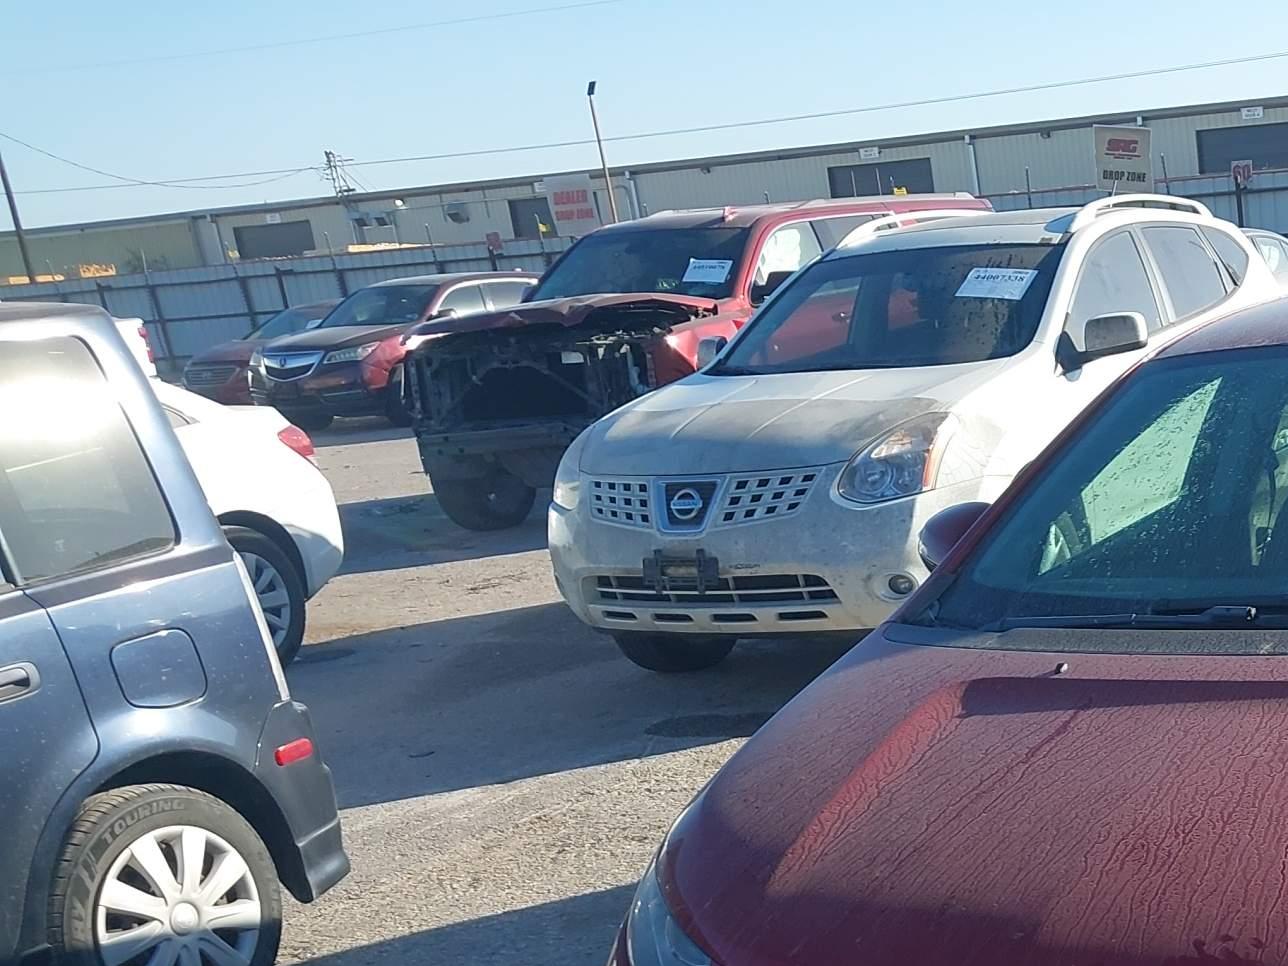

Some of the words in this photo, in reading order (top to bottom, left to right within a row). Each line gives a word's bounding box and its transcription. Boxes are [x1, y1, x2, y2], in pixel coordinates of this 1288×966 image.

[1103, 170, 1125, 180] DROP
[1126, 172, 1146, 182] ZONE
[553, 190, 588, 205] DEALER
[102, 800, 185, 845] TOURING
